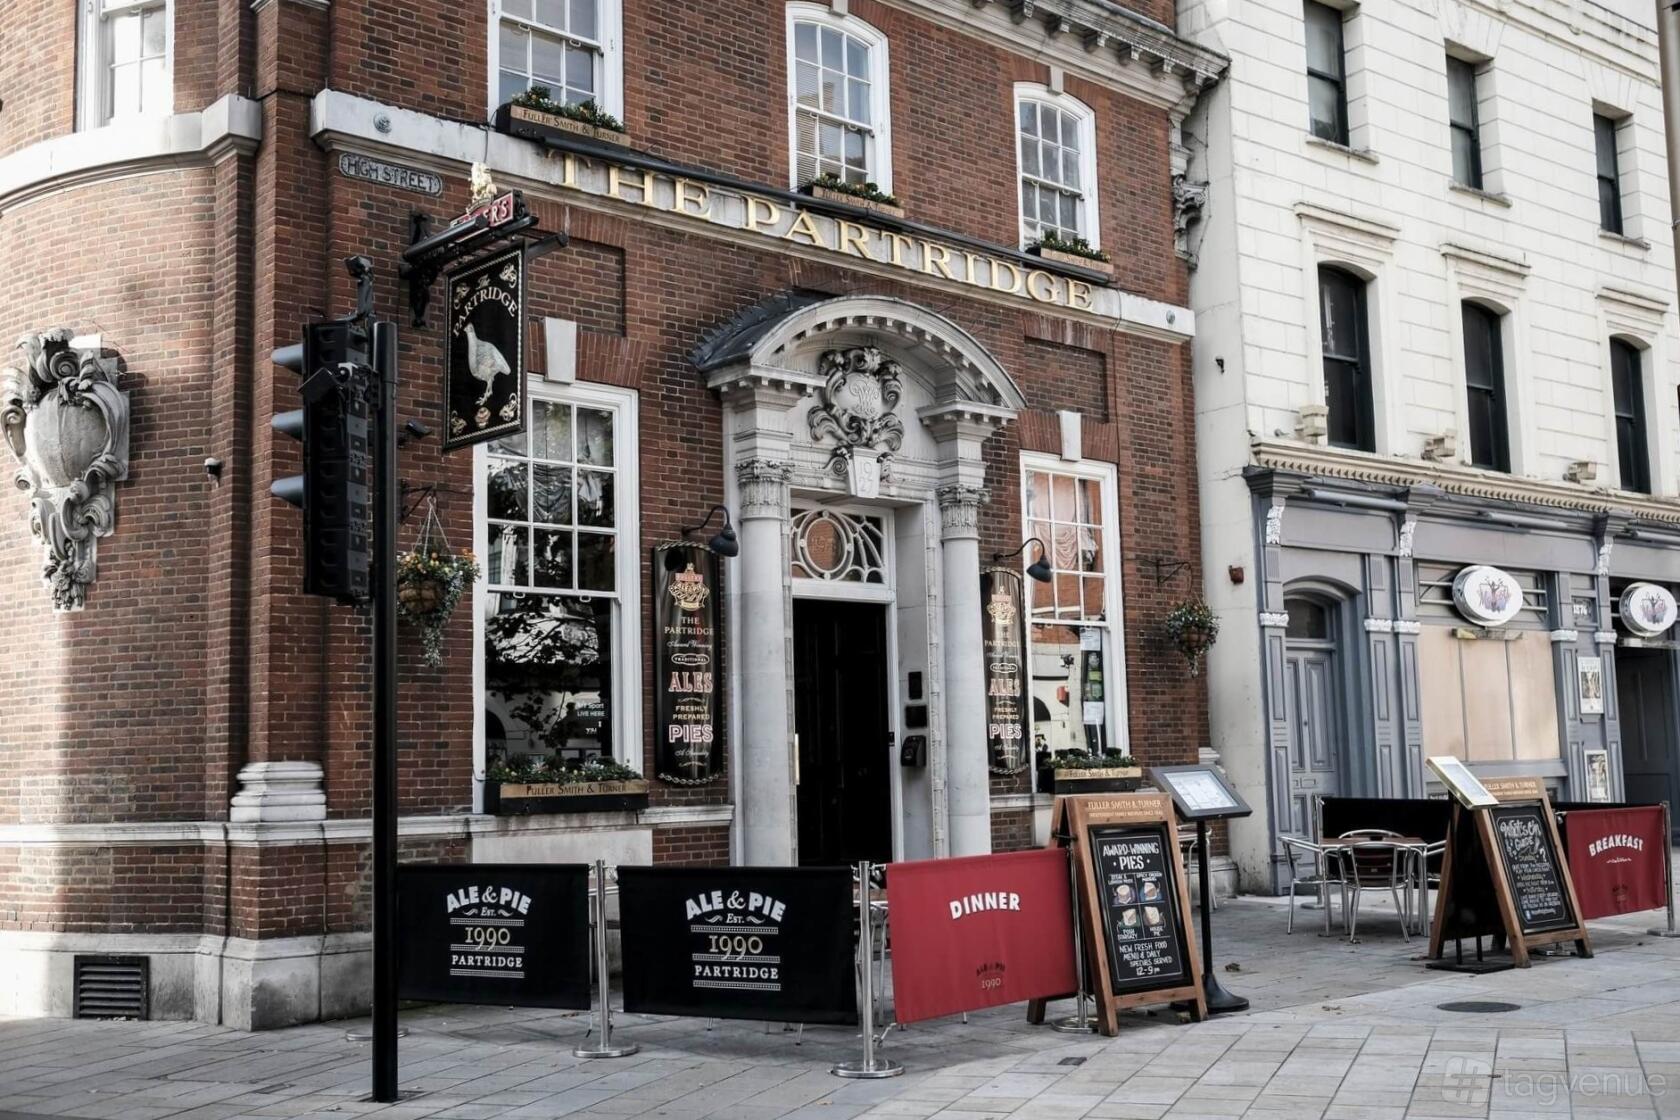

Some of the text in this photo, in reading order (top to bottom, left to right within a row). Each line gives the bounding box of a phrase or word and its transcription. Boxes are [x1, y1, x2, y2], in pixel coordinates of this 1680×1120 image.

[582, 122, 590, 135] &
[347, 157, 434, 192] HIGH STREET
[549, 152, 1095, 313] THE PARTRIDGE
[453, 286, 518, 337] PARTRIDGE
[682, 617, 700, 625] THE
[664, 626, 713, 636] PARTRIDGE
[668, 671, 713, 693] ALES
[988, 678, 1021, 697] ALES
[668, 724, 713, 743] PIES
[989, 723, 1022, 740] PIES
[526, 782, 625, 796] FULLER SMITH & TURNER
[1088, 801, 1110, 810] FULLER
[1111, 800, 1131, 810] SMITH
[1138, 799, 1161, 808] TURNER
[1589, 834, 1643, 856] BREAKFAST
[1119, 855, 1144, 870] PIES
[446, 886, 532, 915] ALE & PIE
[686, 890, 786, 922] ALE & PIE
[949, 892, 1021, 920] DINNER
[465, 927, 510, 951] 1990
[709, 935, 763, 960] 1990
[1119, 941, 1168, 953] NEW FRESH FOOD
[452, 955, 522, 967] PARTRIDGE
[1146, 950, 1161, 958] DAILY
[694, 965, 779, 979] PARTRIDGE
[981, 977, 1001, 991] 1990
